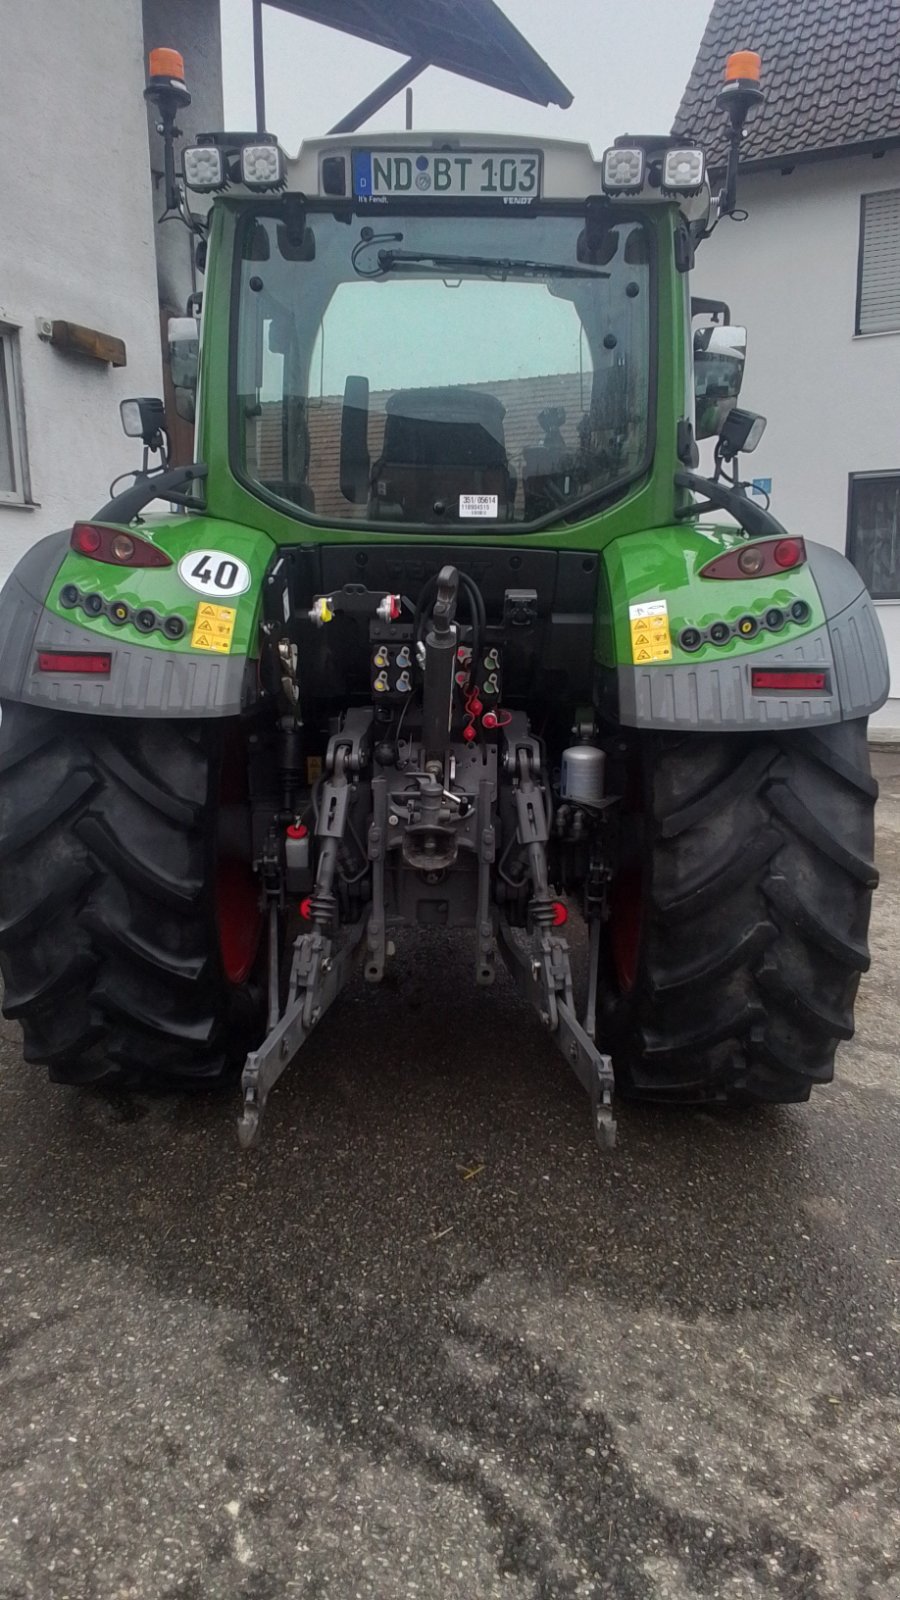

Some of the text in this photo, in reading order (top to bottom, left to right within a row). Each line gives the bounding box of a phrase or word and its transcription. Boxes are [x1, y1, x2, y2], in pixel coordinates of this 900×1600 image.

[360, 178, 367, 187] D
[373, 157, 537, 192] ND BT 103
[191, 555, 239, 589] 40
